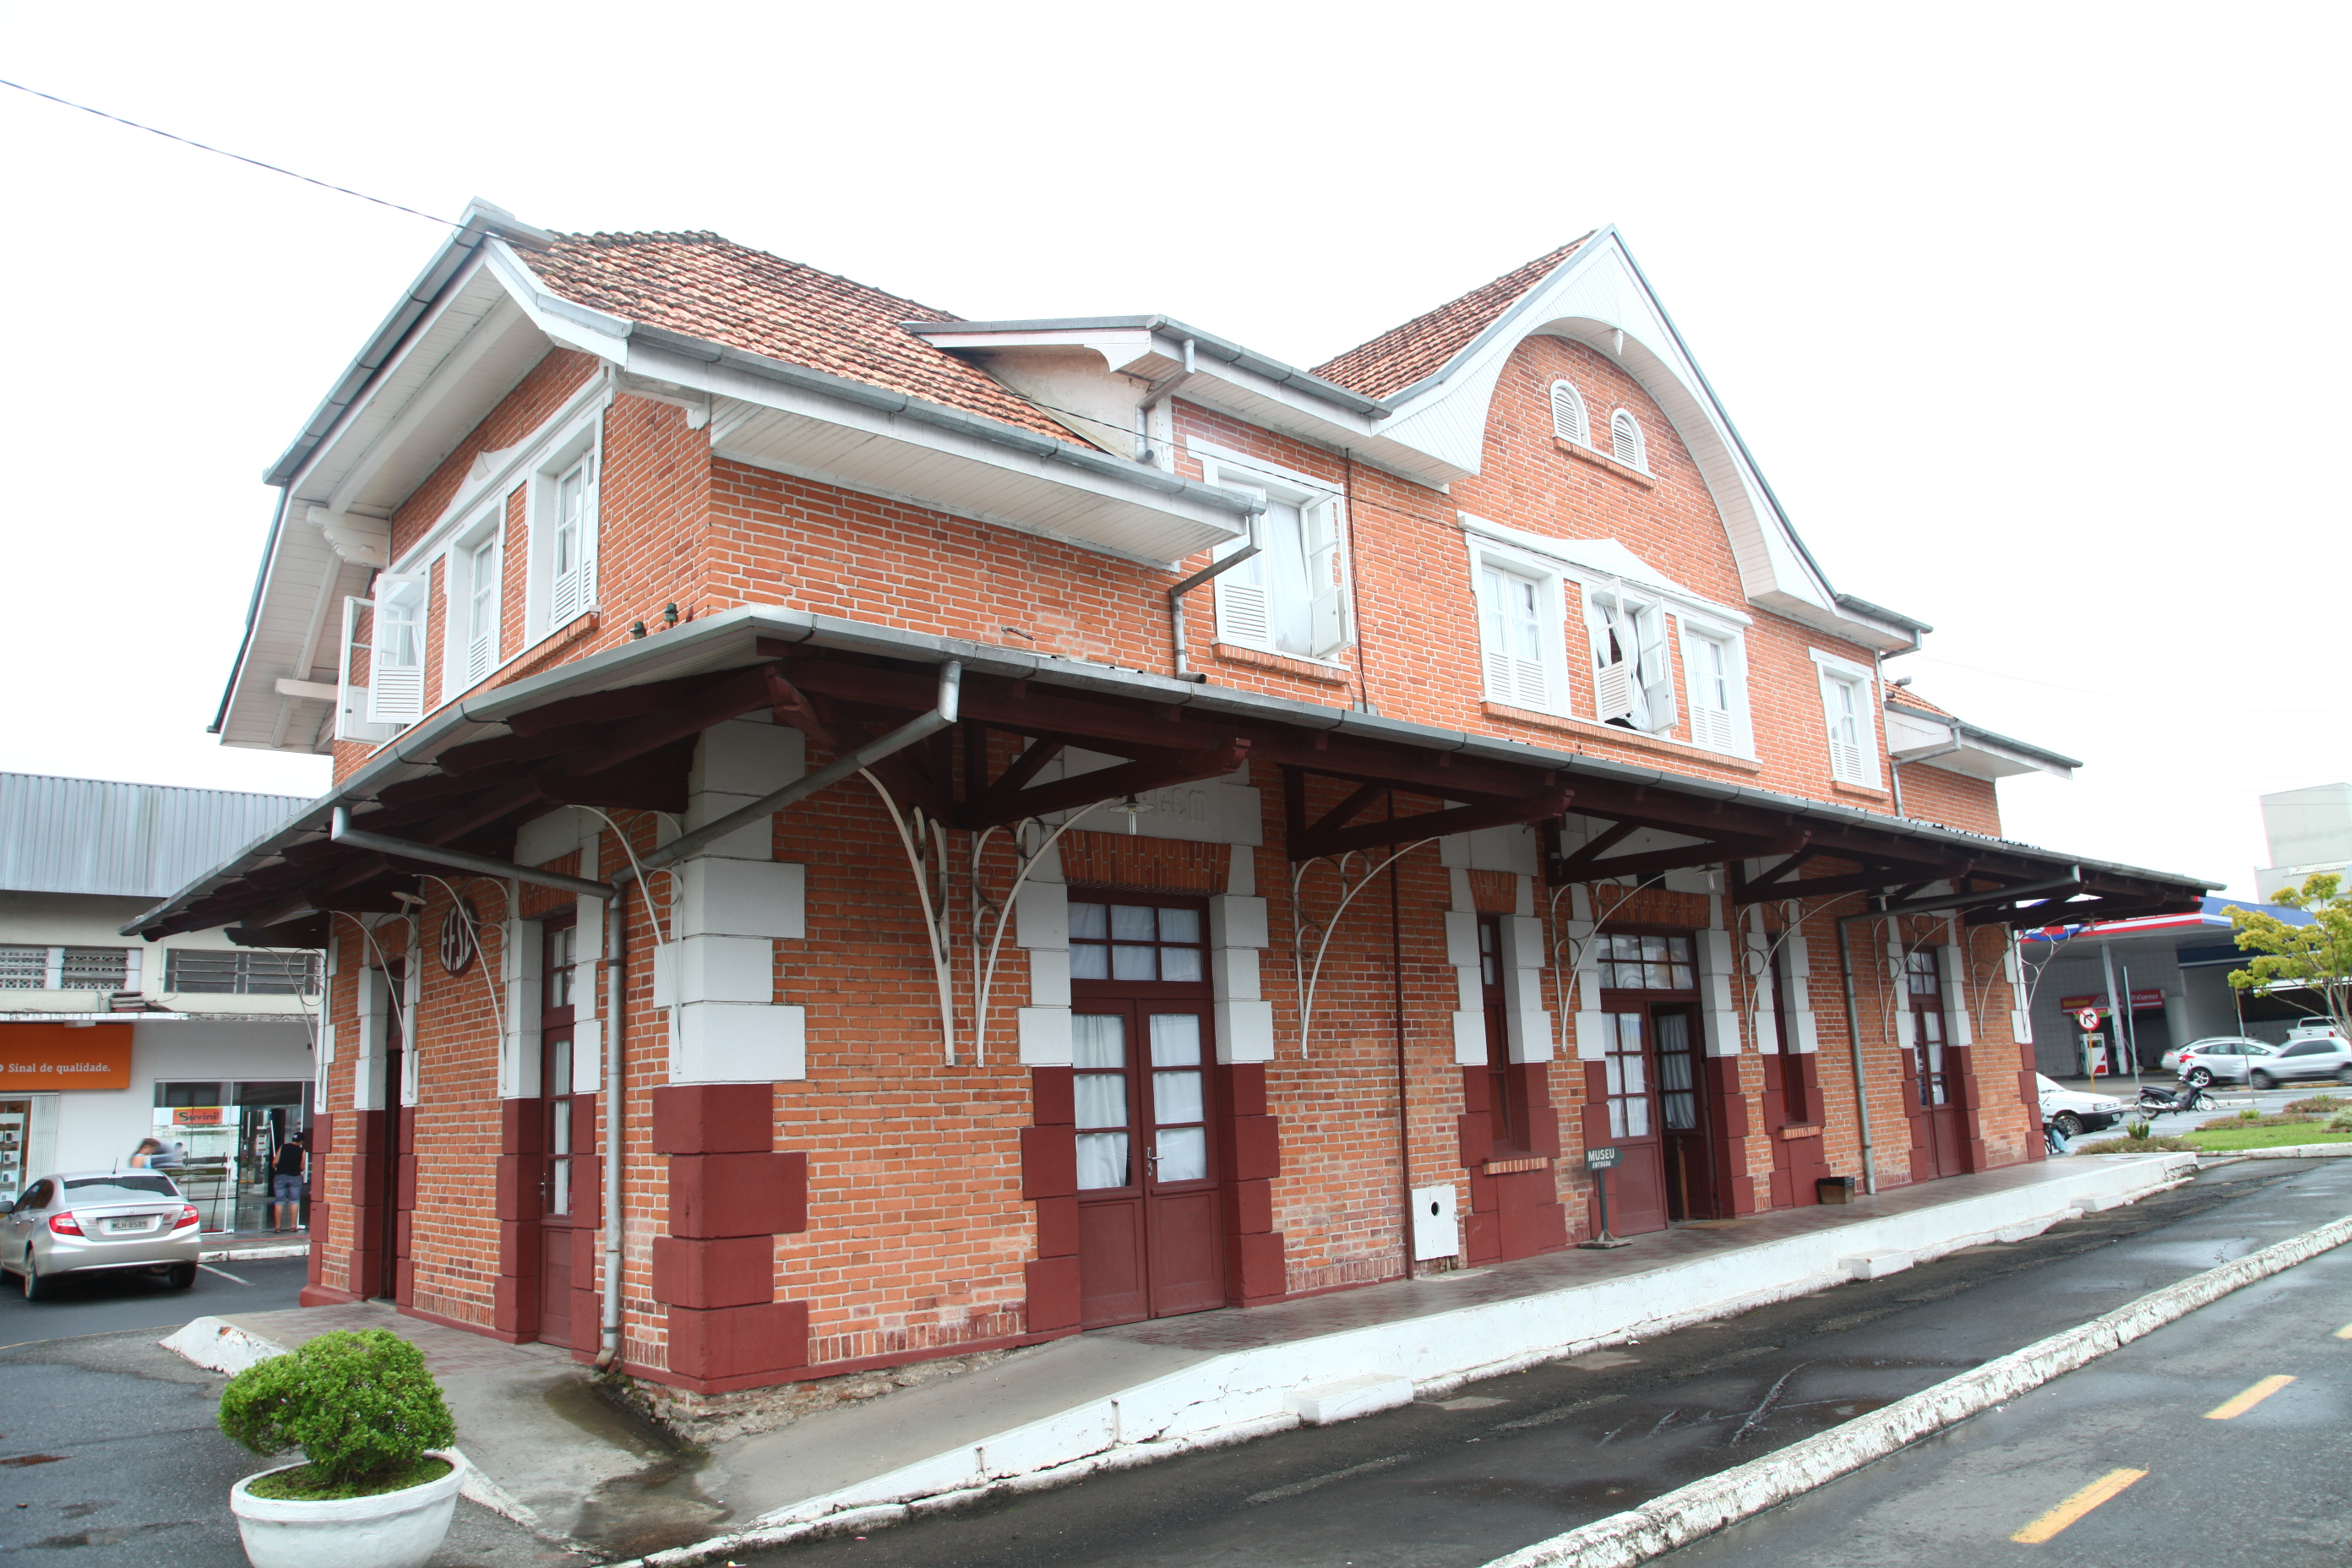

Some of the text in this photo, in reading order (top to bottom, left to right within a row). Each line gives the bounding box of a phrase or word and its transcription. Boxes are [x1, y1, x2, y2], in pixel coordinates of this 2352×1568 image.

[8, 1063, 36, 1073] Sinal
[40, 1063, 53, 1073] de
[57, 1063, 111, 1074] qualidade.
[177, 1112, 219, 1122] Suvinil
[1588, 1148, 1614, 1162] MUSEU
